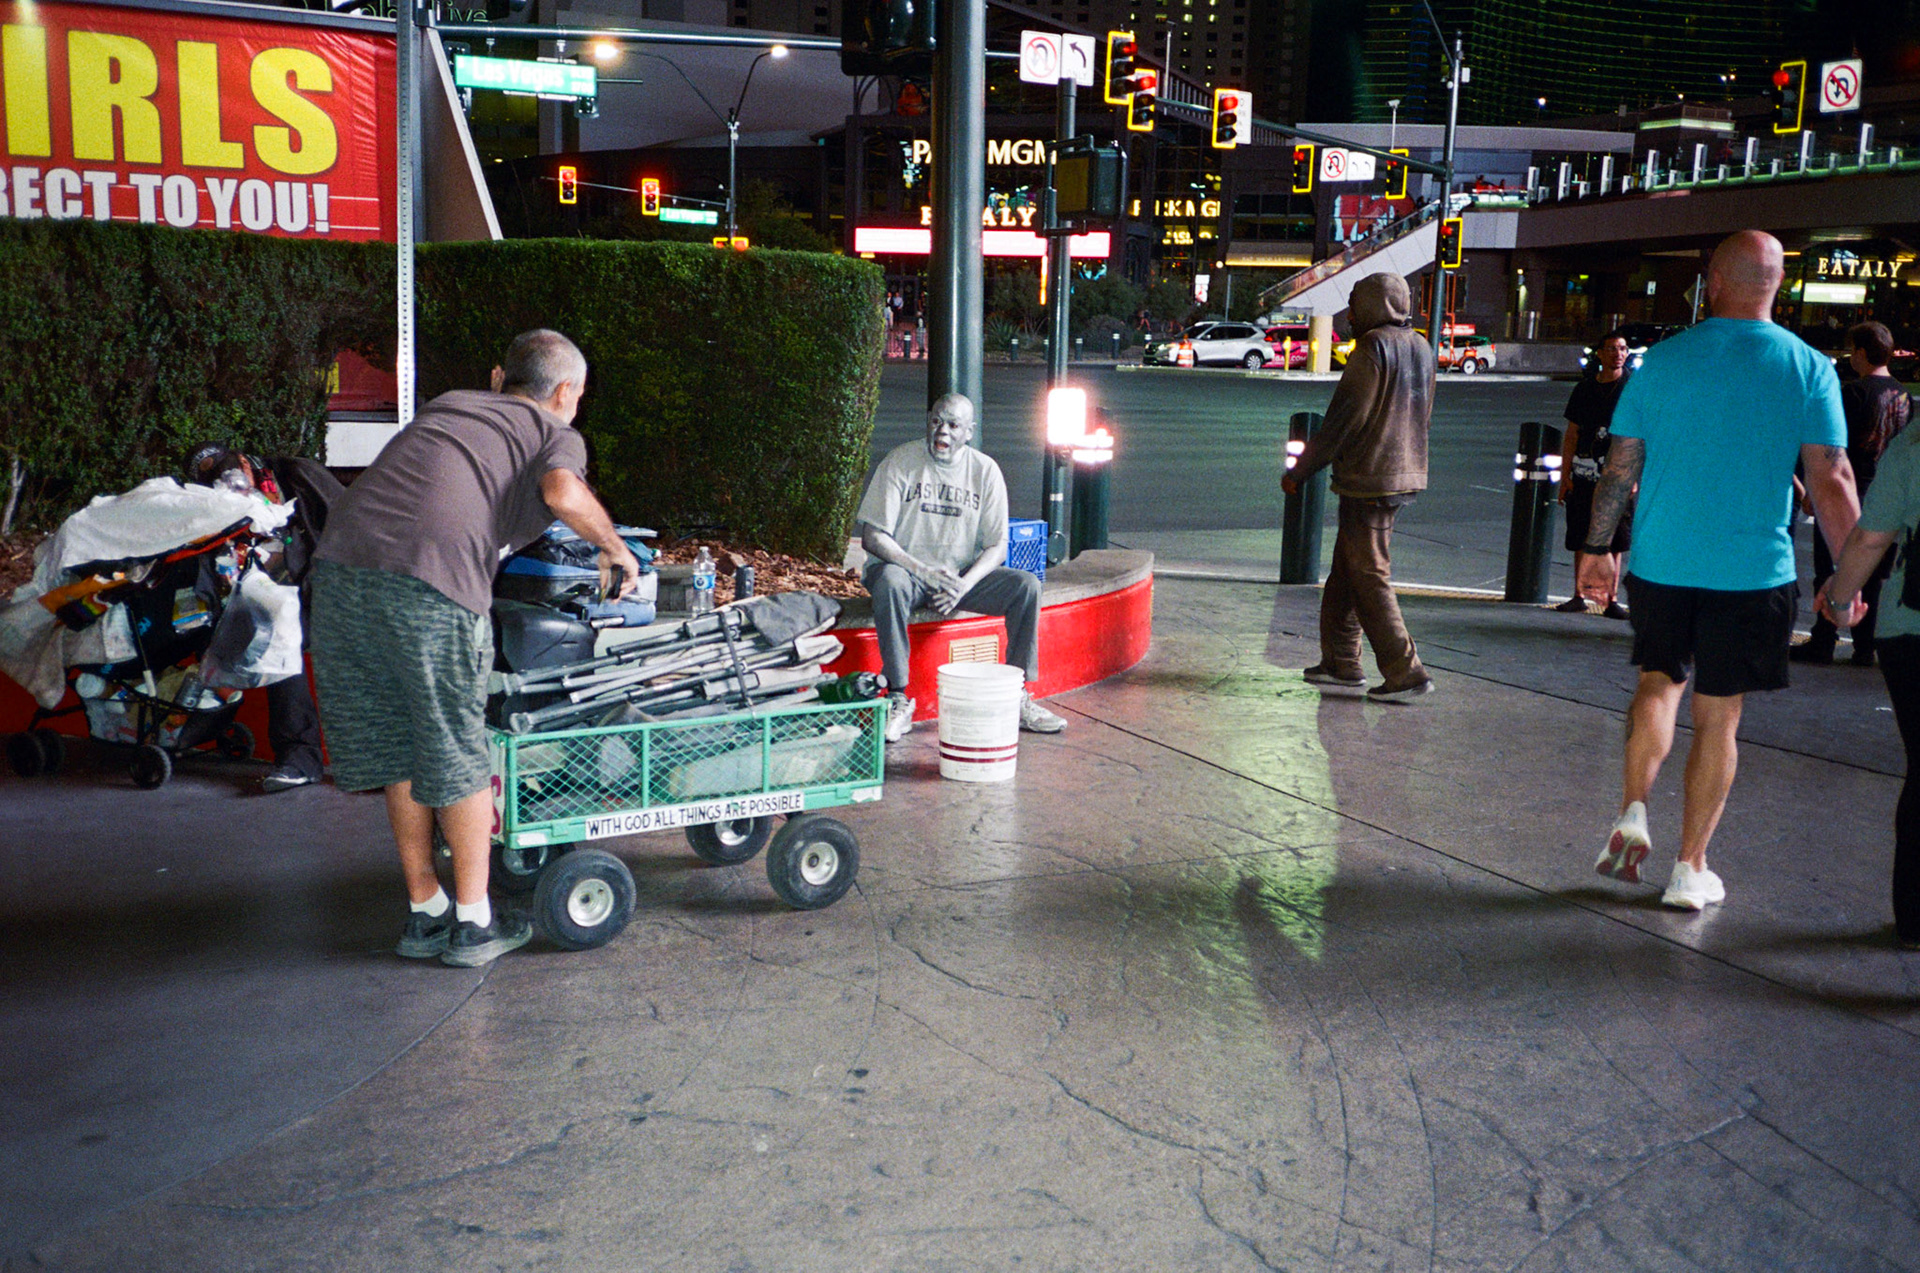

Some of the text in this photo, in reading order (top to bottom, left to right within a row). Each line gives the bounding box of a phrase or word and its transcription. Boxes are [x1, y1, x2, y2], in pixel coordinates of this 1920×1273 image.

[472, 57, 505, 82] Las
[507, 60, 564, 91] Vegas
[2, 24, 339, 175] IRLS
[987, 139, 1057, 165] MGM
[129, 173, 198, 228] TO
[204, 177, 330, 233] YOU!
[1817, 257, 1903, 278] EATALY
[905, 482, 981, 510] LAS VEGAS
[587, 793, 802, 837] WITH GOD ALL THINGS ARE POSSIBLE
